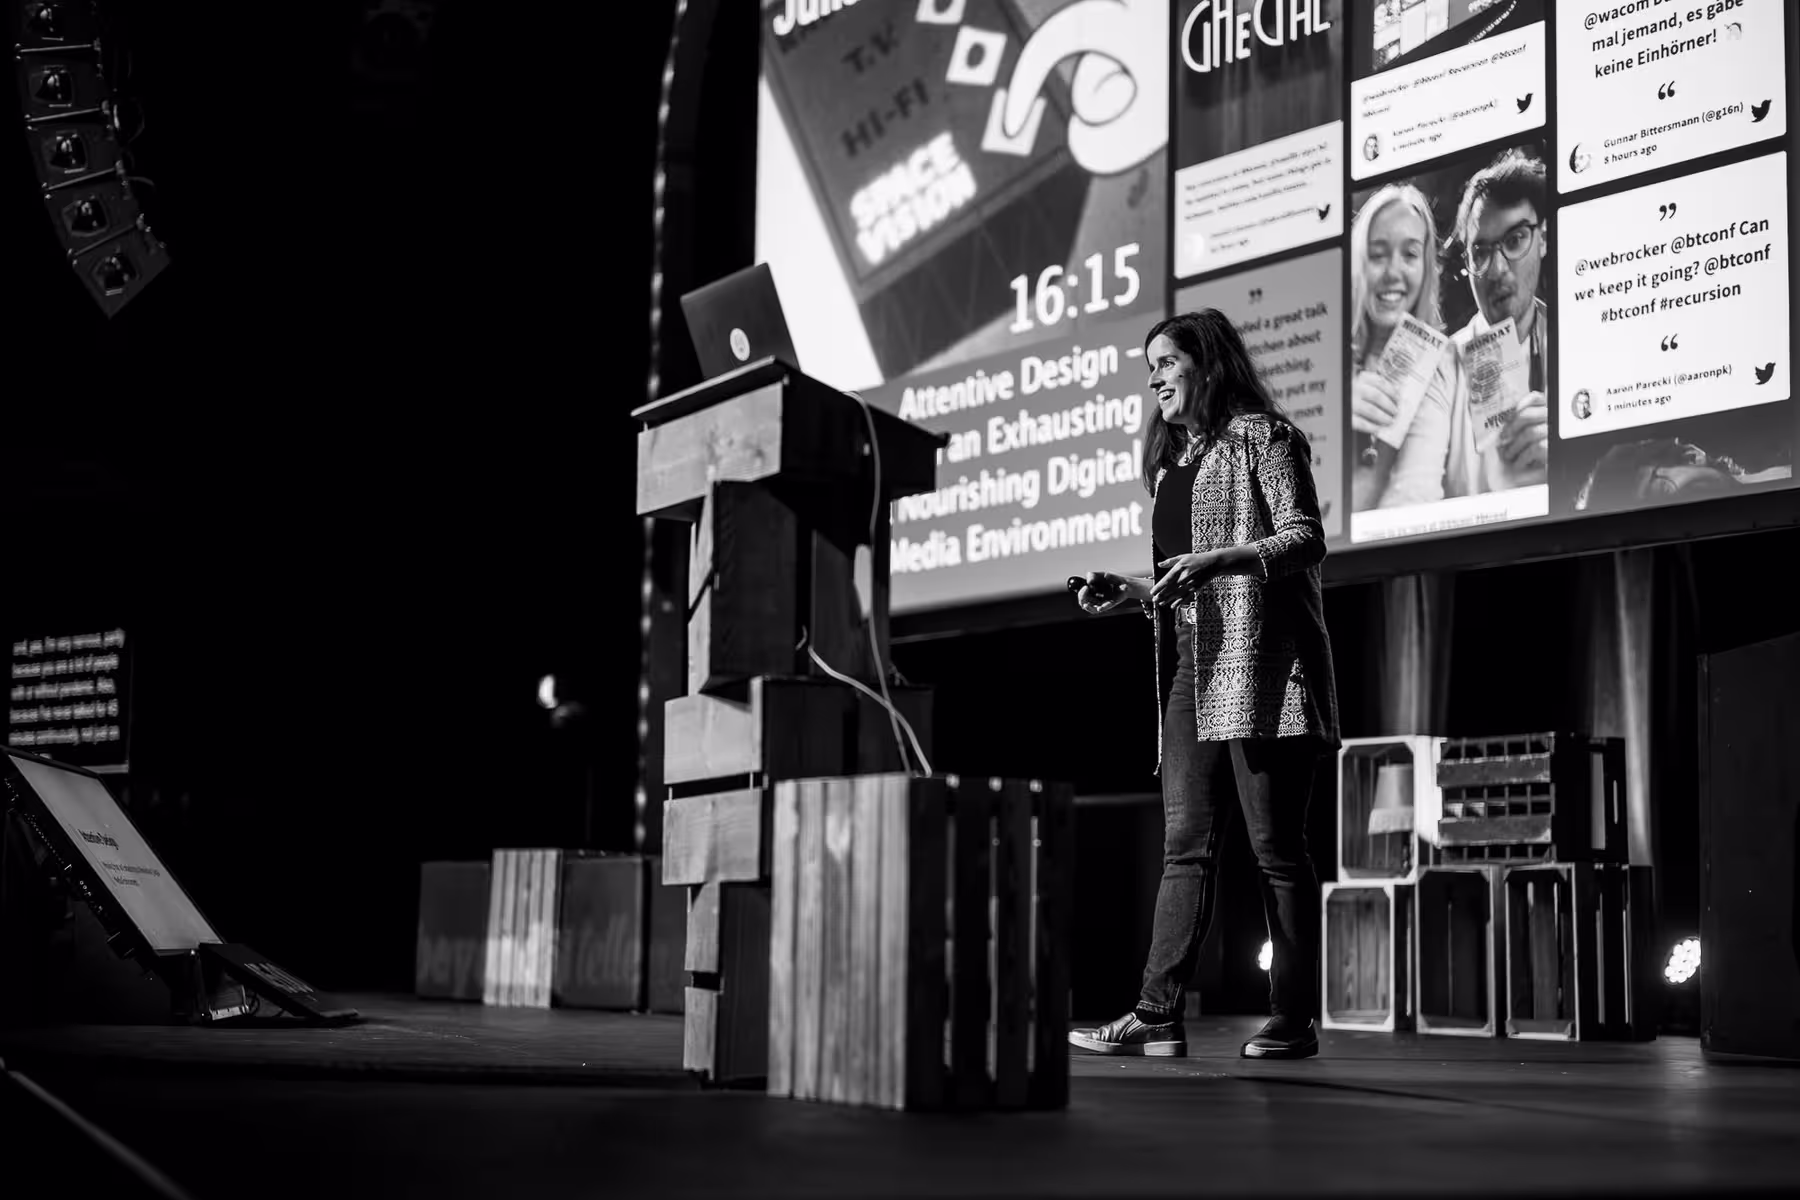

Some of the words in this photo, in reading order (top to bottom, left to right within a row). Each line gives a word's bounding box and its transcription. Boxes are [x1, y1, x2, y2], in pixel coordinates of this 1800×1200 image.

[1583, 0, 1651, 31] @wacom
[1592, 31, 1619, 52] mal
[1620, 12, 1684, 47] jemand,
[1686, 8, 1703, 23] es
[1594, 56, 1634, 79] keine
[1637, 28, 1718, 66] Einhörner!
[839, 78, 931, 157] HI-FI
[1603, 132, 1639, 149] Gunnar
[1640, 115, 1701, 138] Bittersmann
[1701, 101, 1745, 124] (@g16n)
[1611, 148, 1639, 163] hours
[1640, 142, 1658, 157] ago
[1574, 240, 1668, 276] @webrocker
[1669, 222, 1738, 255] @btconf
[1739, 216, 1770, 236] Can
[1574, 286, 1595, 302] we
[1598, 276, 1634, 298] keep
[1636, 272, 1648, 288] it
[1650, 261, 1701, 289] going?
[1703, 243, 1773, 276] @btconf
[1009, 242, 1141, 334] 16:15
[1600, 298, 1658, 324] #btconf
[1659, 281, 1742, 312] #recursion
[898, 369, 1016, 421] Attentive
[1020, 344, 1119, 396] Design
[1605, 383, 1634, 396] Aaron
[1635, 376, 1672, 391] Parecki
[1673, 363, 1733, 387] (@aaronpk)
[1654, 394, 1673, 406] ago
[987, 394, 1143, 457] Exhausting
[897, 468, 1041, 524] Nourishing
[1047, 439, 1143, 499] Digital
[966, 501, 1144, 564] Environment
